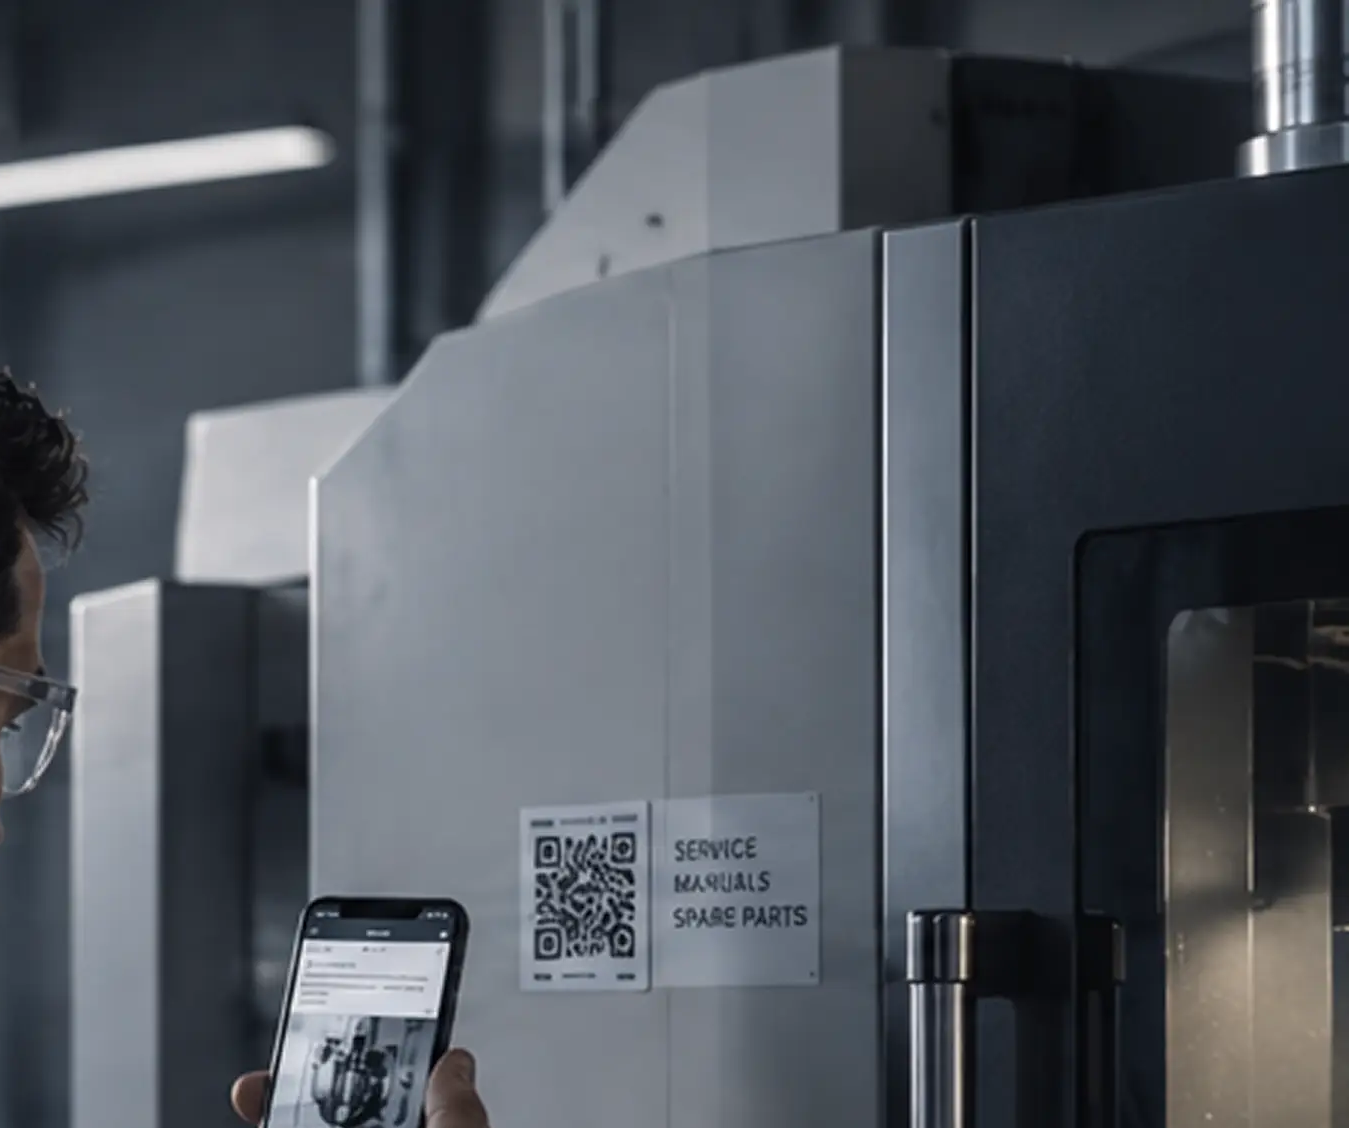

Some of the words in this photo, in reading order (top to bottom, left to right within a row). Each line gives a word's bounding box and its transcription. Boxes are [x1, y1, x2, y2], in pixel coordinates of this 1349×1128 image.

[674, 836, 757, 862] SERVICE
[673, 906, 736, 928] SPARE
[742, 905, 808, 928] PARTS
